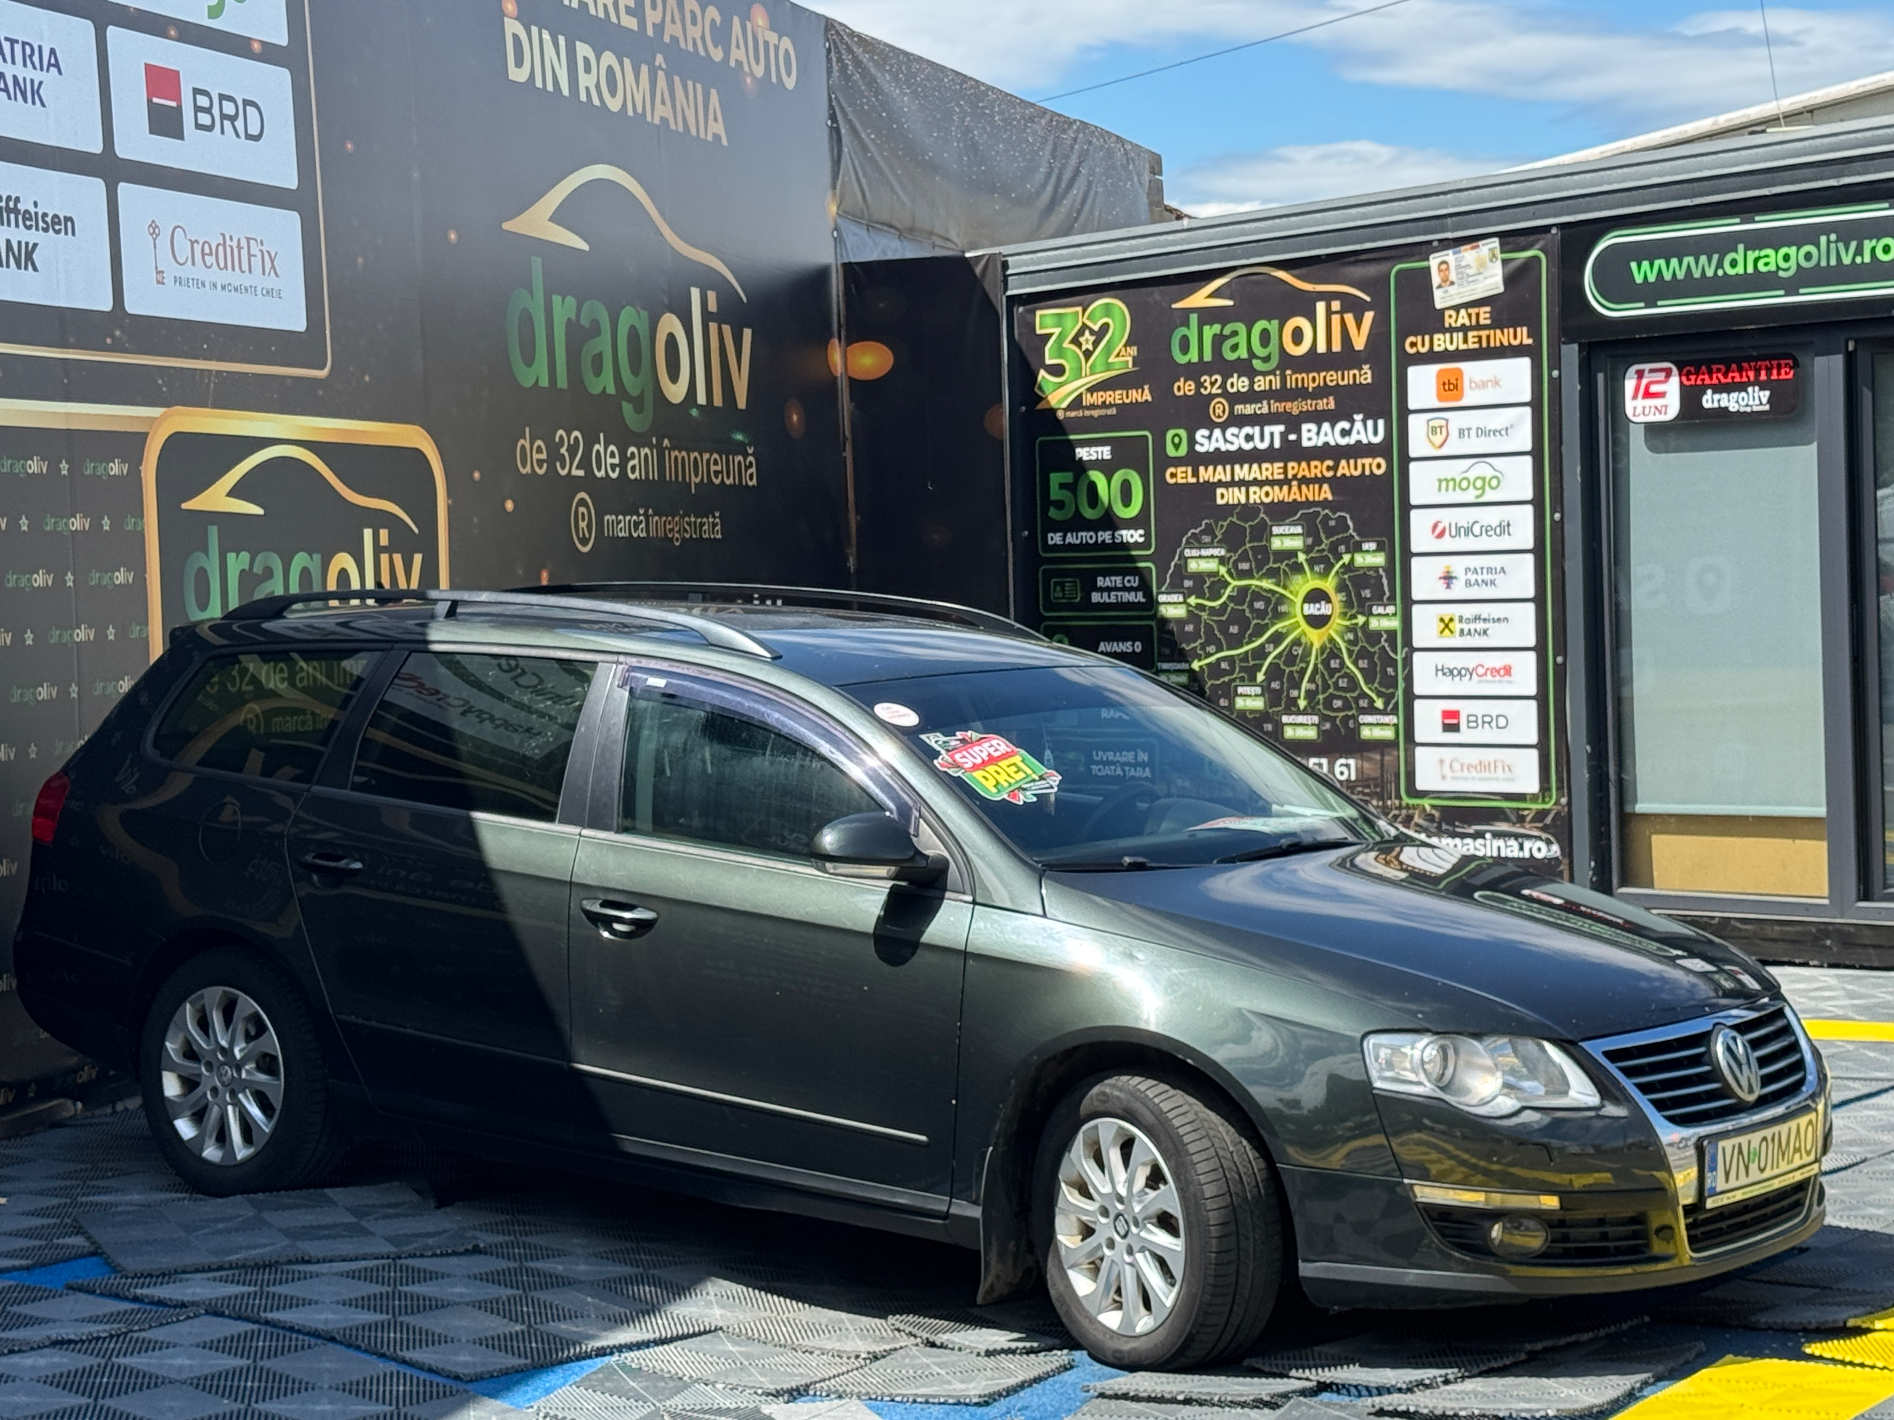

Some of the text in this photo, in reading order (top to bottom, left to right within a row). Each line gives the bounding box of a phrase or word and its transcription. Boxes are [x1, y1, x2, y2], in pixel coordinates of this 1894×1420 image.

[729, 15, 797, 91] AUTO
[504, 16, 728, 147] DIN ROMÂNIA
[192, 87, 265, 142] BRD
[170, 224, 280, 279] CreditFix
[1629, 233, 1894, 285] www.dragoliv.ro
[173, 275, 206, 289] PRIETEN
[209, 280, 218, 291] IN
[1444, 306, 1491, 328] RATE
[505, 256, 752, 433] dragoliv
[1171, 300, 1375, 372] dragoliv
[1404, 326, 1533, 354] CU BULETINUL
[1034, 297, 1131, 400] 32
[1173, 364, 1372, 396] de 32 de ani împreună
[1469, 374, 1501, 390] bank
[1631, 366, 1673, 401] 12
[1681, 359, 1796, 386] GARANTIE
[1082, 385, 1152, 406] ÎMPREUNĂ
[1441, 377, 1459, 392] tbi
[1234, 400, 1269, 416] marcă
[1270, 396, 1335, 415] înregistrată
[1632, 403, 1669, 418] LUNI
[1702, 386, 1771, 413] dragoliv
[1194, 424, 1285, 453] SASCUT
[1301, 413, 1385, 448] BACĂU
[1430, 424, 1444, 436] BT
[1458, 427, 1472, 439] BT
[516, 427, 757, 494] de 32 de ani împreună
[1075, 445, 1112, 461] PESTE
[1, 456, 48, 477] dragoliv
[82, 458, 129, 480] dragoliv
[1165, 456, 1387, 484] CEL MAI MARE PARC AUTO
[1047, 468, 1144, 521] 500
[1215, 480, 1333, 505] DIN ROMÂNIA
[1437, 475, 1502, 499] mogo
[43, 513, 91, 535] dragoliv
[604, 508, 647, 538] marcă
[649, 508, 722, 547] înregistrată
[1449, 520, 1512, 538] UniCredit
[1047, 529, 1145, 545] DE AUTO PE STOC
[1096, 575, 1139, 588] RATE CU
[1465, 566, 1507, 576] PATRIA
[1465, 578, 1498, 588] BANK
[1091, 591, 1146, 603] BULETINUL
[1459, 614, 1509, 625] Raiffeisen
[1459, 628, 1490, 638] BANK
[1098, 641, 1132, 653] AVANS
[1435, 663, 1513, 681] HappyCredit
[1466, 714, 1509, 730] BRD
[953, 738, 1014, 769] SUPER
[1334, 757, 1357, 782] 61
[1450, 757, 1513, 774] CreditFix
[1722, 1140, 1751, 1185] VN
